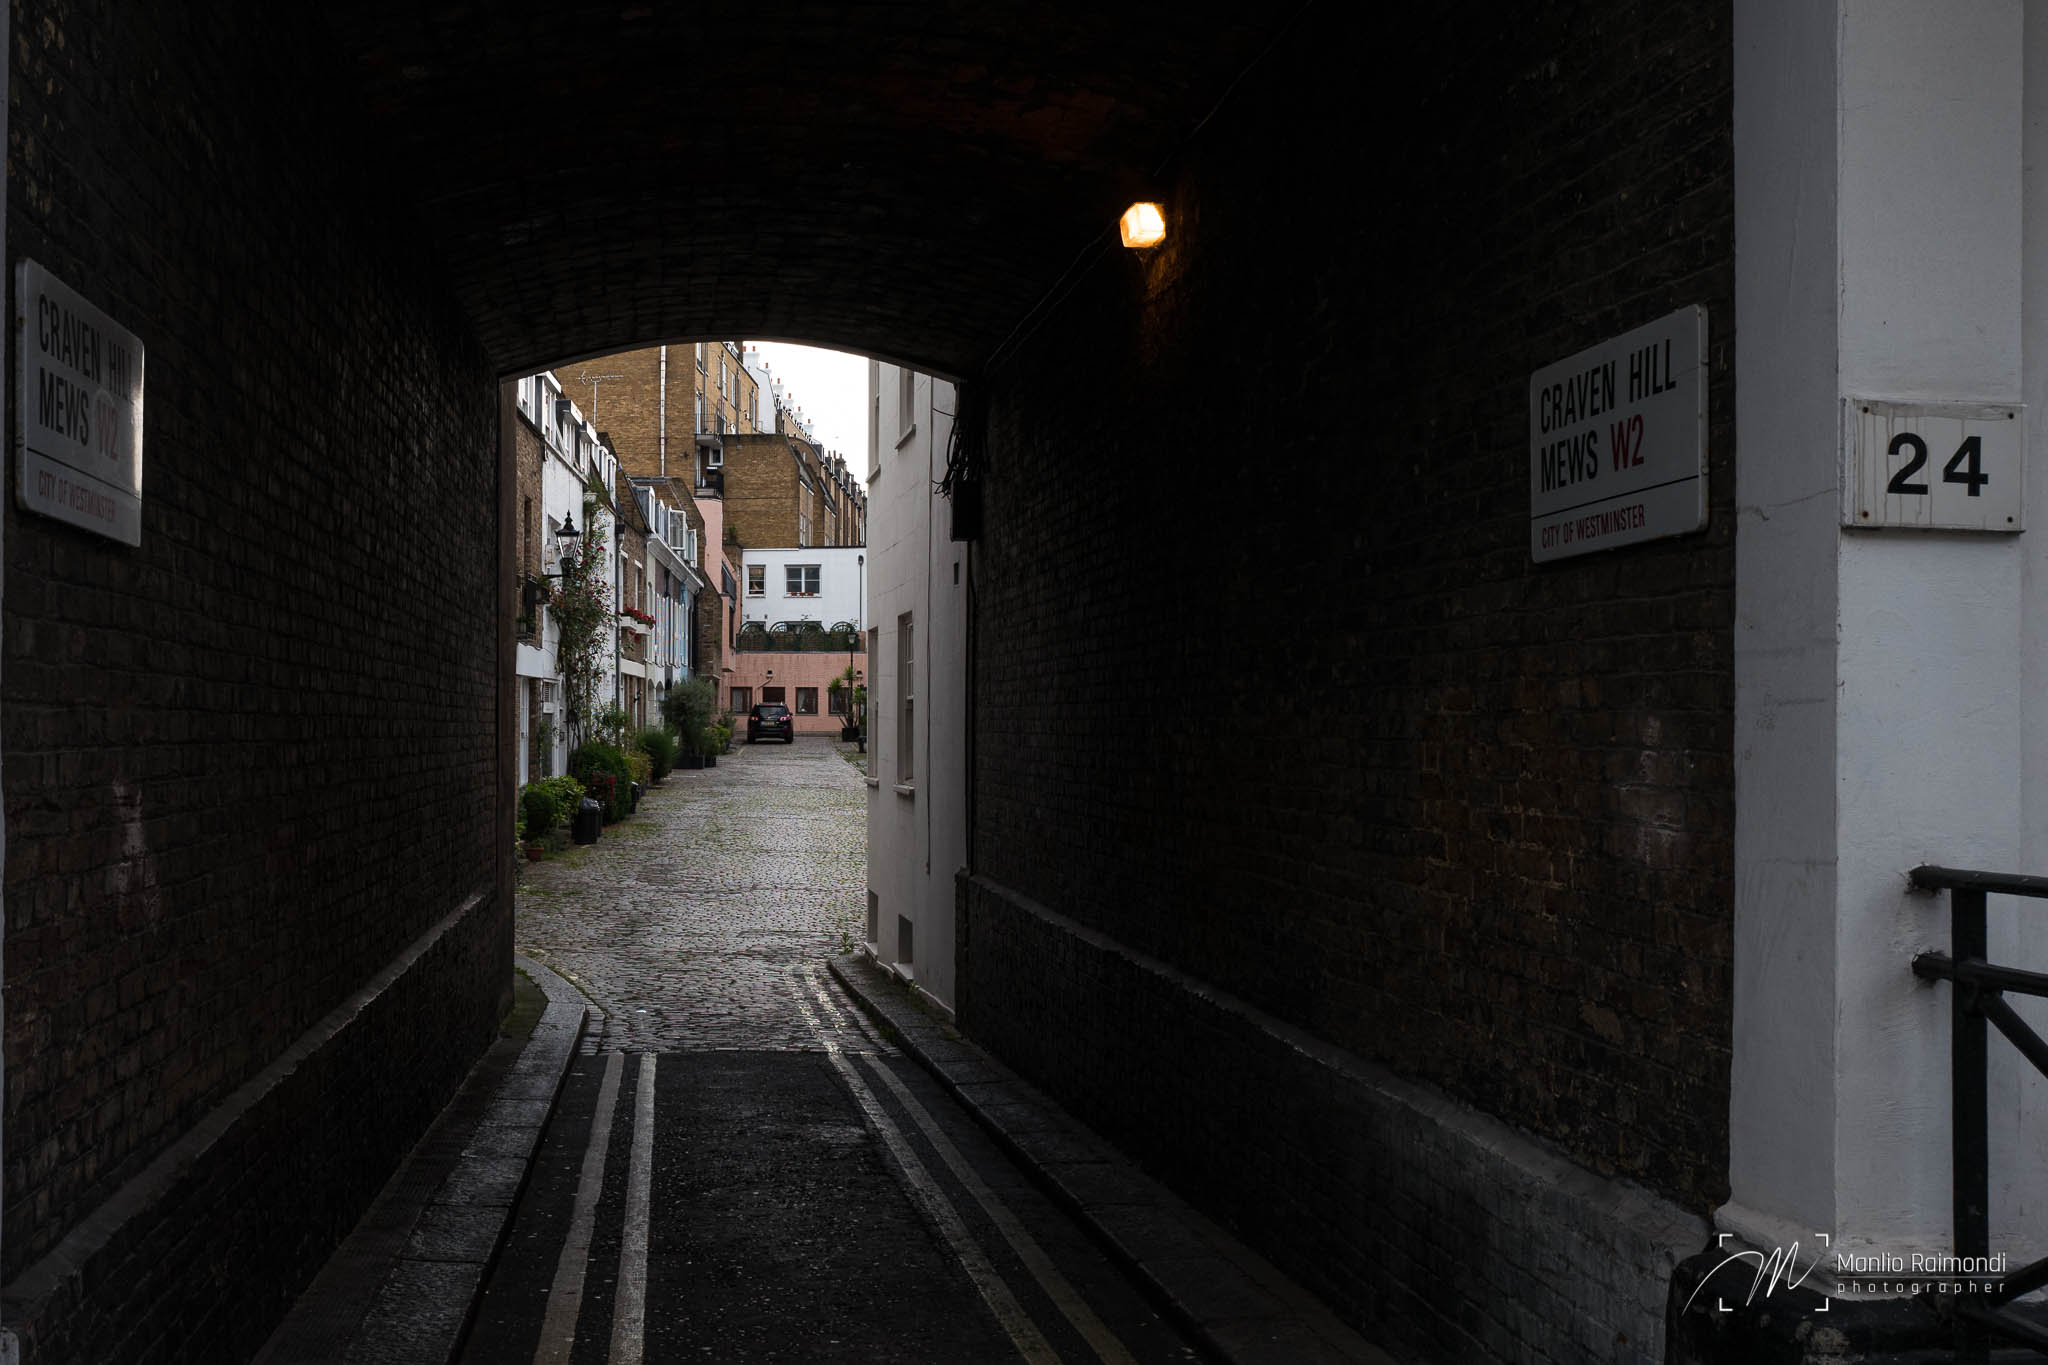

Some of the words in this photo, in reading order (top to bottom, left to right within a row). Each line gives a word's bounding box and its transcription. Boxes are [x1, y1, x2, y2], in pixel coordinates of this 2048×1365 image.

[39, 293, 100, 385] CRAVEN
[39, 366, 90, 446] MEWS
[96, 398, 119, 461] W2
[1540, 360, 1616, 434] CRAVEN
[1629, 339, 1677, 403] HILL
[1541, 430, 1598, 492] MEWS
[1610, 414, 1645, 472] W2
[1887, 432, 1989, 497] 24
[39, 470, 56, 498] CITY
[58, 480, 68, 505] OF
[69, 483, 116, 522] WESTMINSTER
[1542, 524, 1560, 549] CITY
[1564, 521, 1574, 544] OF
[1576, 504, 1646, 541] WESTMINSTER
